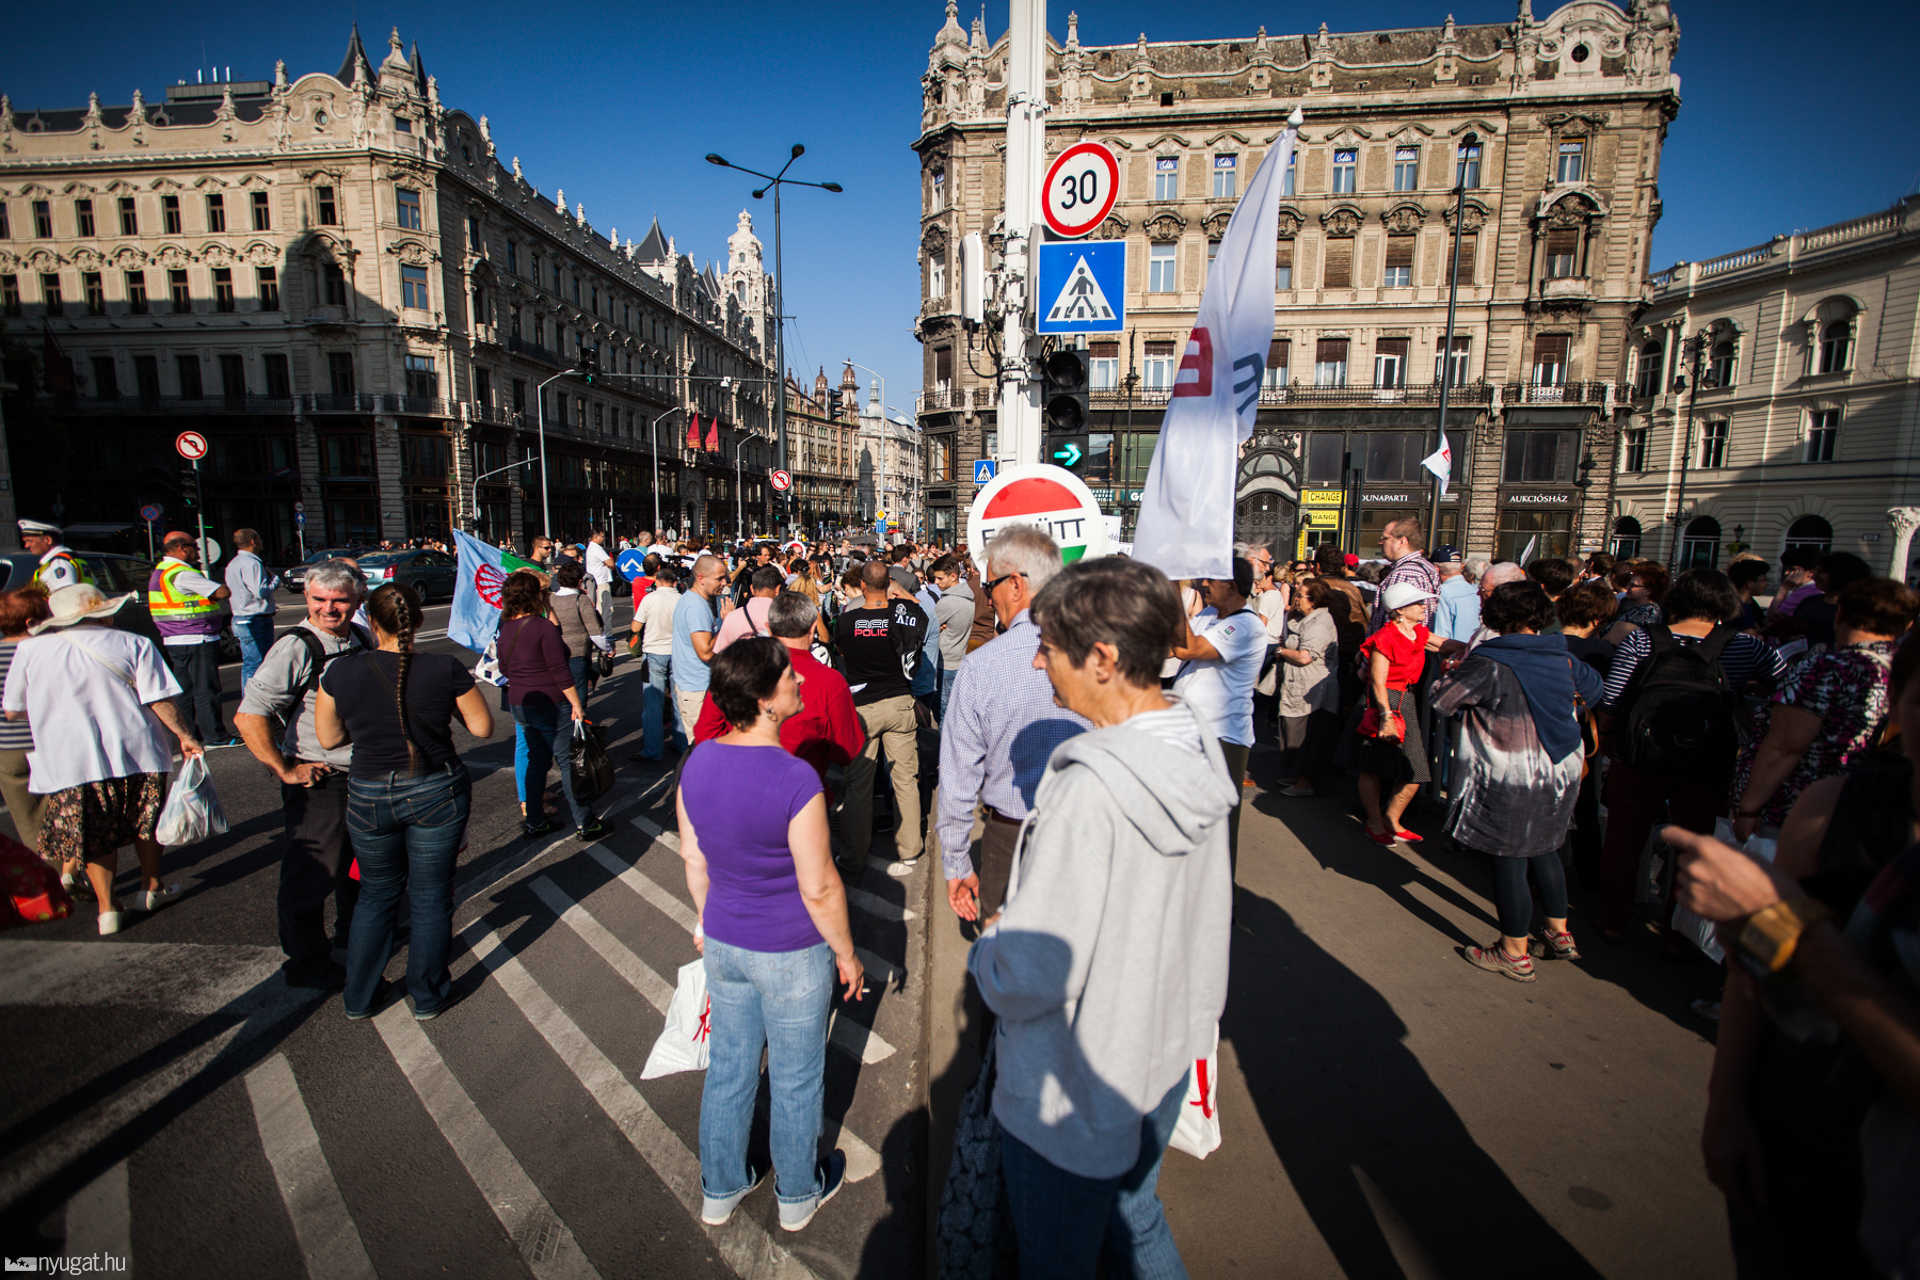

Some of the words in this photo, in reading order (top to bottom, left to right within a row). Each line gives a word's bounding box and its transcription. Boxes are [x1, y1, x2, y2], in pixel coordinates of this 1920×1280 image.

[1061, 169, 1097, 210] 30
[1310, 492, 1340, 501] CHANGE
[1509, 493, 1568, 503] AUKCIÓSHÁZ
[981, 517, 1086, 548] EÜTT
[853, 628, 888, 637] POLIC
